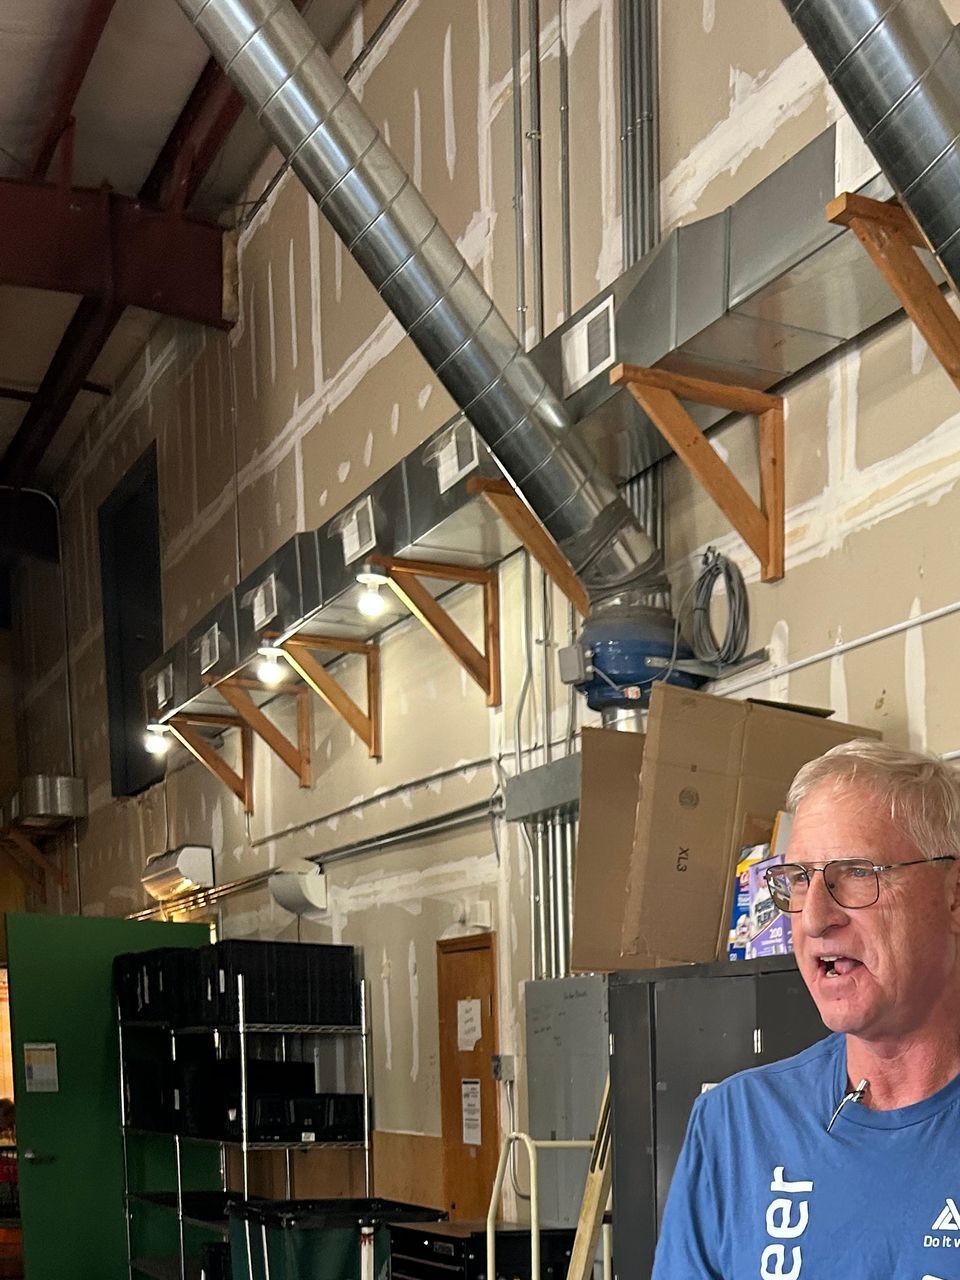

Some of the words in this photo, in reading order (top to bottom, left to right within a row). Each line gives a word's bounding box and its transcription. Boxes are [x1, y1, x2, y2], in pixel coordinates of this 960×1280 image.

[676, 846, 690, 872] XL3
[923, 1235, 940, 1249] Do
[942, 1235, 952, 1248] it
